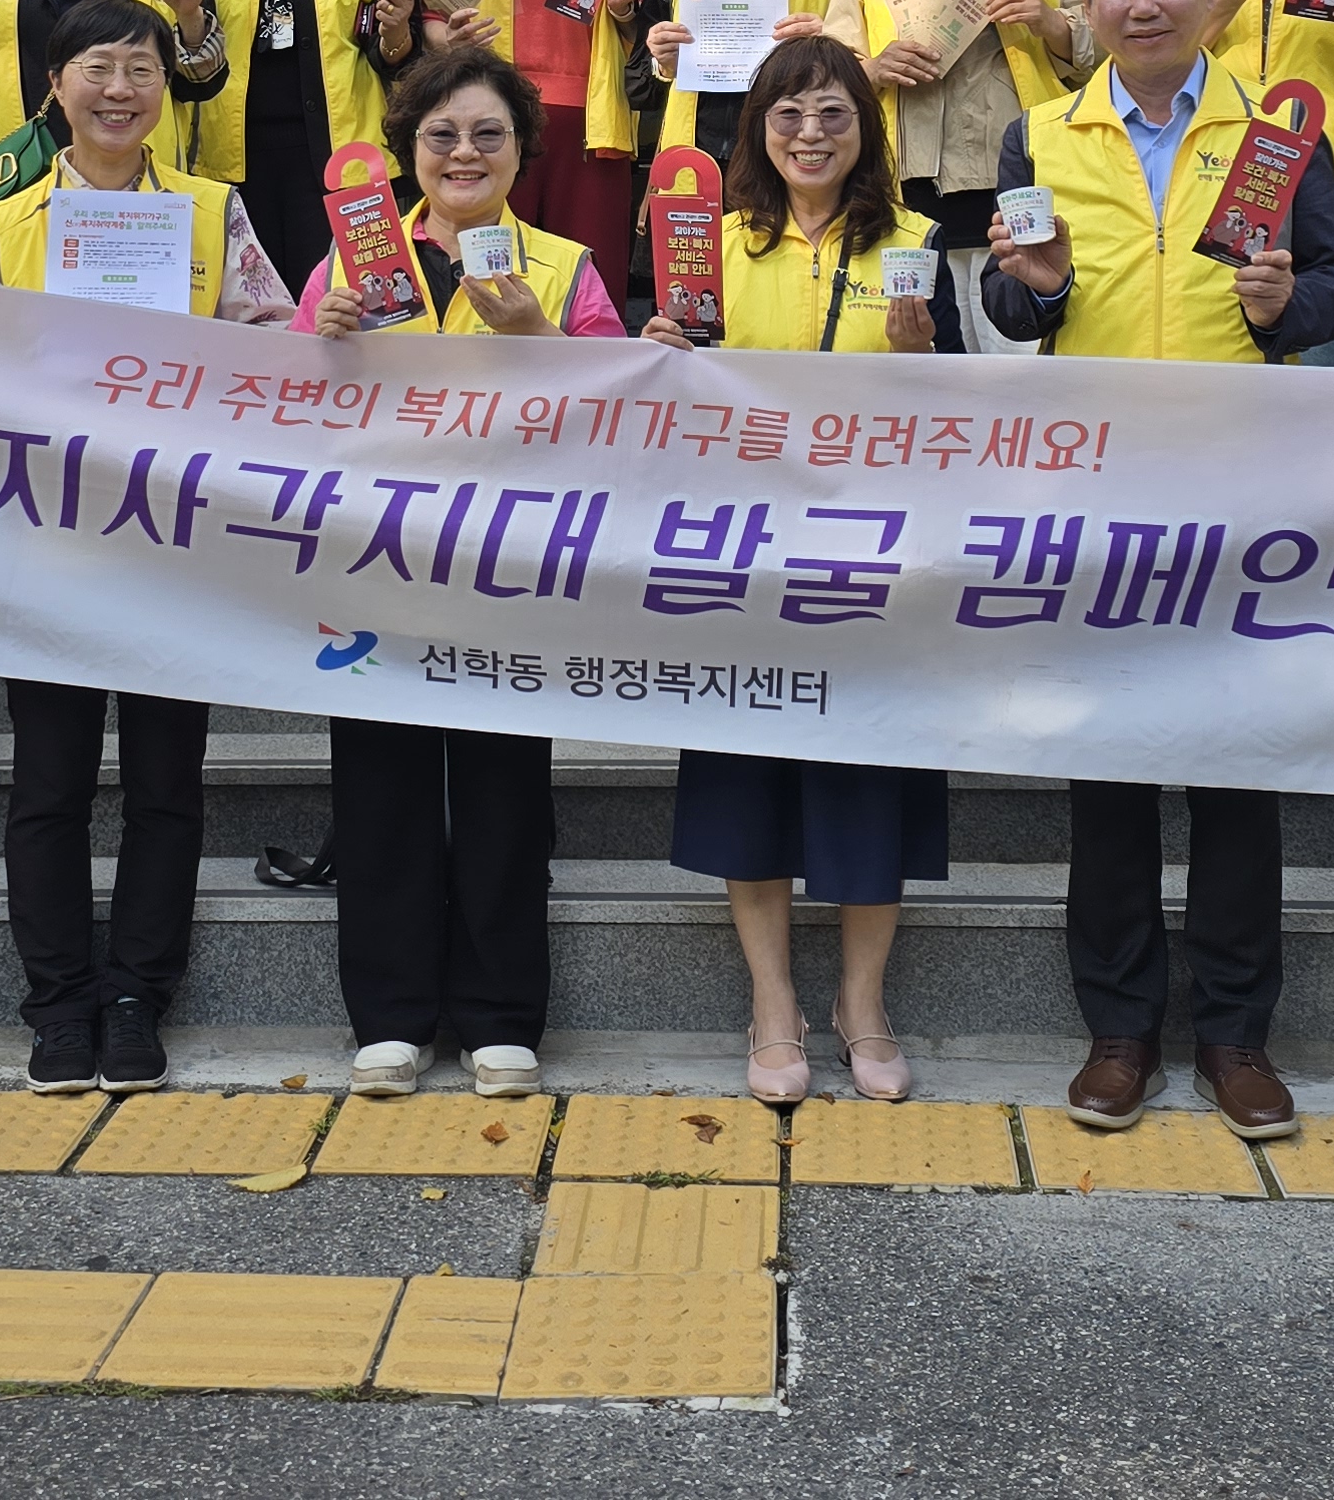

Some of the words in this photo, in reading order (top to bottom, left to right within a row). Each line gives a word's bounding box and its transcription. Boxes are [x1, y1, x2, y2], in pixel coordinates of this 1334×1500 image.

[1195, 149, 1233, 169] Yeo
[1242, 160, 1291, 187] 보건·복지
[1245, 177, 1277, 198] 서비스
[1256, 194, 1281, 213] 안내
[73, 209, 88, 218] 우리
[91, 211, 114, 219] 주변의
[345, 218, 392, 243] 보건·복지
[674, 226, 707, 237] 찾아가는
[356, 234, 389, 252] 서비스
[376, 242, 399, 260] 안내
[667, 237, 714, 251] 보건·복지
[675, 250, 706, 263] 서비스
[692, 263, 714, 276] 안내
[847, 280, 885, 298] Yeo
[93, 353, 205, 415] 우리
[217, 371, 380, 432] 주변의
[394, 385, 501, 441] 복지
[806, 413, 1112, 474] 알려주세요!
[642, 497, 909, 626] 발굴
[419, 643, 548, 694] 선학동
[565, 652, 829, 716] 행정복지센터
